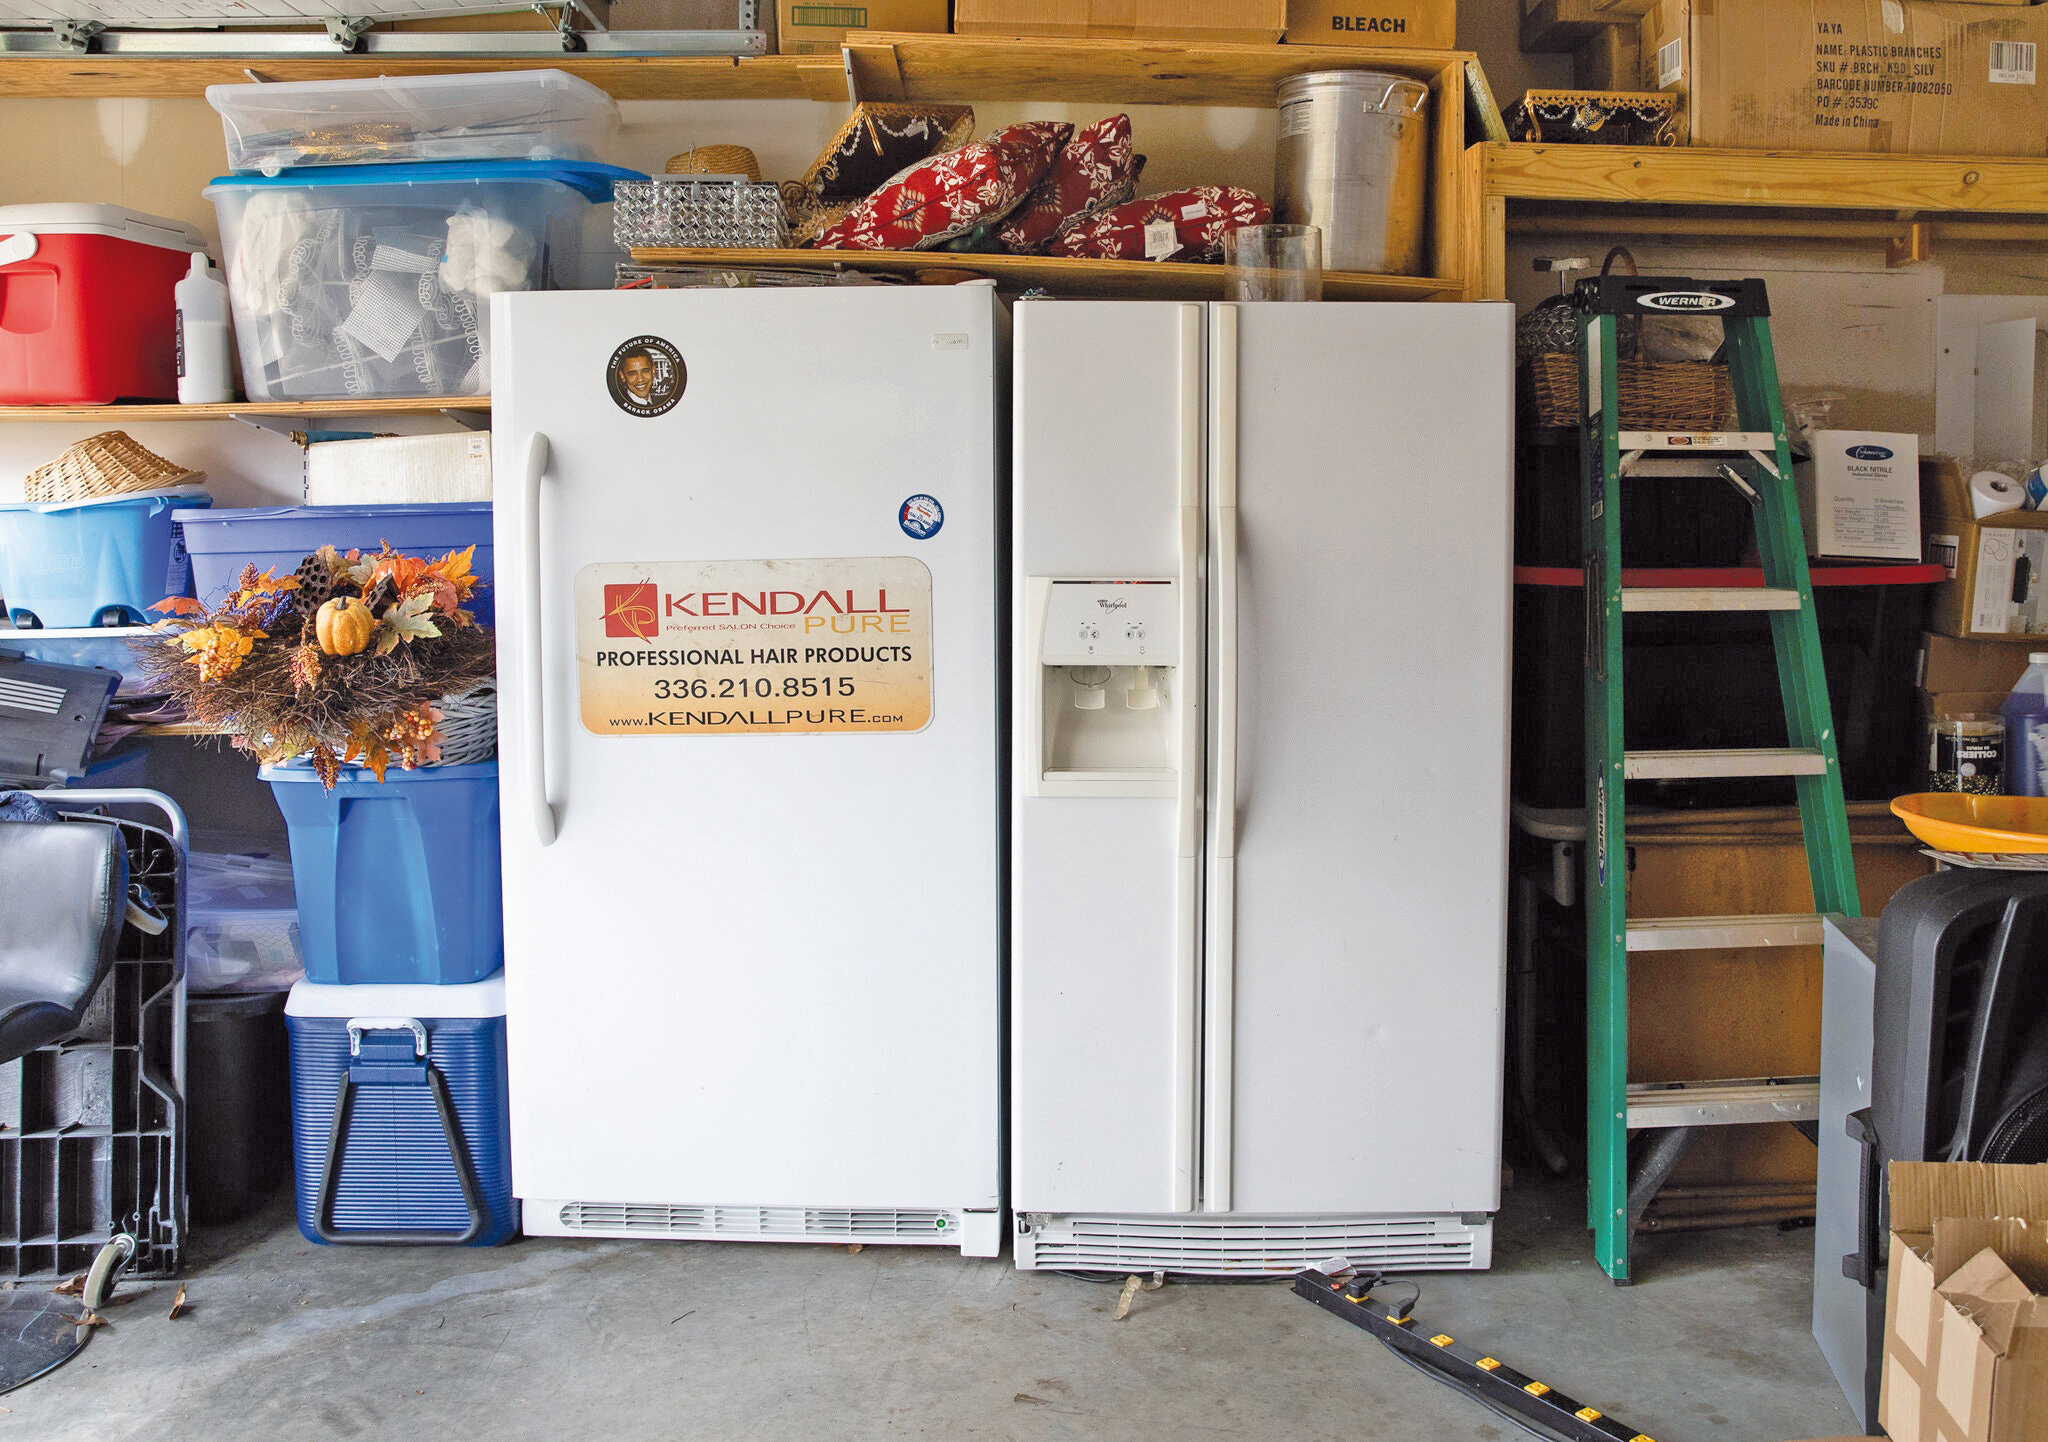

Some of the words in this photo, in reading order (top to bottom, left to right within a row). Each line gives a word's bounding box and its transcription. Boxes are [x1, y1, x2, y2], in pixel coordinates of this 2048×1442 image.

[1332, 15, 1405, 33] BLEACH
[1849, 45, 1888, 58] PLASTIC
[1891, 46, 1942, 59] BRANCHES
[1816, 61, 1836, 73] SKU
[1816, 78, 1861, 91] BARCODE
[1816, 95, 1829, 108] PO
[1815, 113, 1840, 127] Made
[1841, 115, 1851, 127] in
[1853, 114, 1879, 129] China
[1658, 296, 1716, 307] WERNER
[611, 356, 620, 369] THE
[618, 338, 643, 356] FUTURE
[655, 340, 680, 363] AMERICA
[623, 402, 651, 415] BARACK
[653, 398, 676, 414] OBAMA
[1847, 465, 1868, 473] BLACK
[1869, 466, 1893, 474] NITRILE
[665, 589, 910, 617] KENDALL
[666, 624, 716, 632] Preferred
[719, 623, 757, 631] SALON
[804, 614, 911, 634] PURE
[596, 649, 744, 667] PROFESSIONAL
[751, 648, 798, 665] HAIR
[805, 646, 912, 664] PRODUCTS
[654, 677, 855, 699] 336.210.8515
